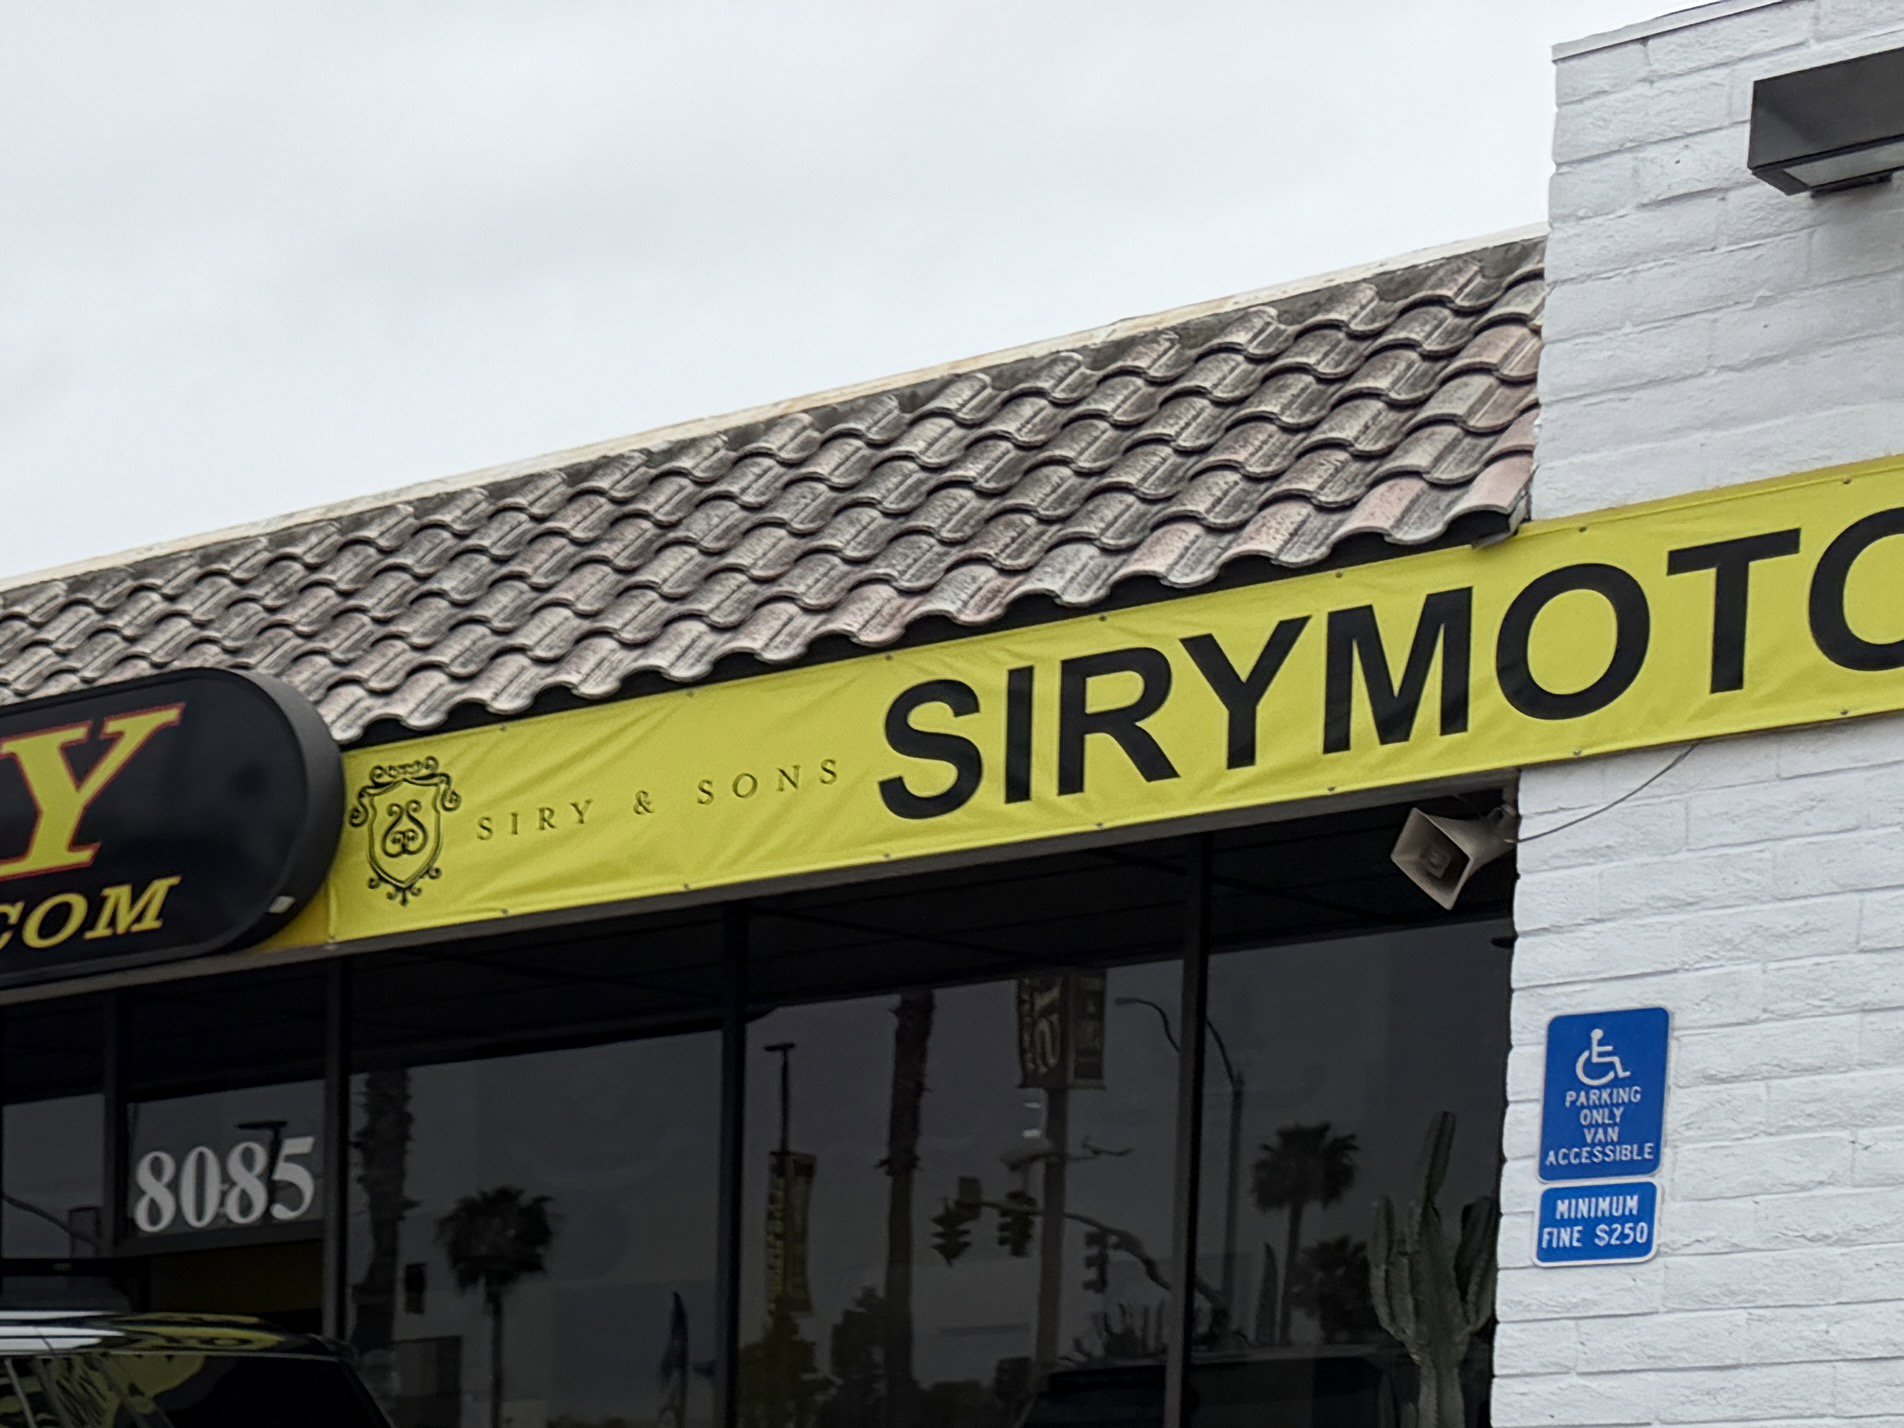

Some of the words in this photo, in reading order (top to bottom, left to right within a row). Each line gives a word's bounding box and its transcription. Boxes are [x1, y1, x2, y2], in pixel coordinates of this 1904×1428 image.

[477, 799, 592, 841] SIRY
[633, 789, 655, 815] &
[697, 758, 838, 805] SONS
[1565, 1086, 1642, 1107] PARKING
[1580, 1106, 1624, 1126] ONLY
[1584, 1127, 1618, 1144] VAN
[1545, 1143, 1655, 1166] ACCESSIBLE
[134, 1136, 315, 1232] 8085
[1555, 1195, 1638, 1220] MINIMUM
[1542, 1226, 1583, 1249] FINE
[1595, 1222, 1648, 1247] $250
